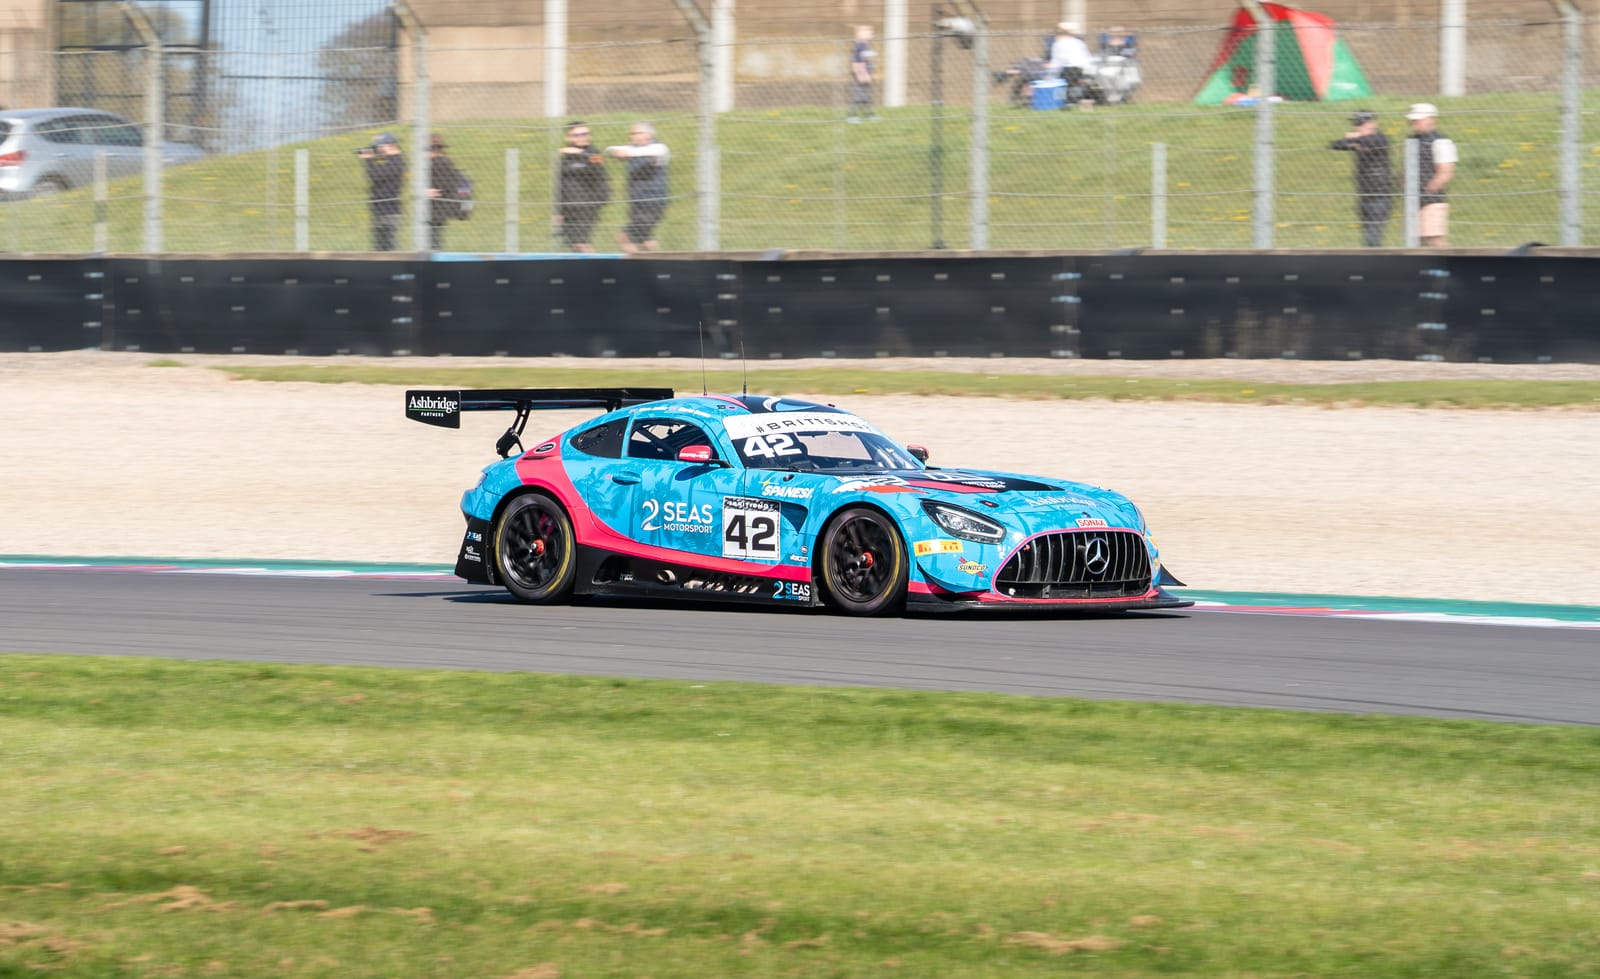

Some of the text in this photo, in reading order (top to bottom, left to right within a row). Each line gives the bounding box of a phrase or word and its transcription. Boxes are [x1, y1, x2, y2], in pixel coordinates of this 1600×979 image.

[409, 395, 458, 414] Ashbridge
[743, 433, 802, 459] 42
[663, 501, 713, 524] SEAS
[663, 523, 713, 534] MOTORSPORT
[1077, 518, 1106, 528] SONAX
[725, 514, 776, 552] 42
[785, 582, 810, 597] SEAS
